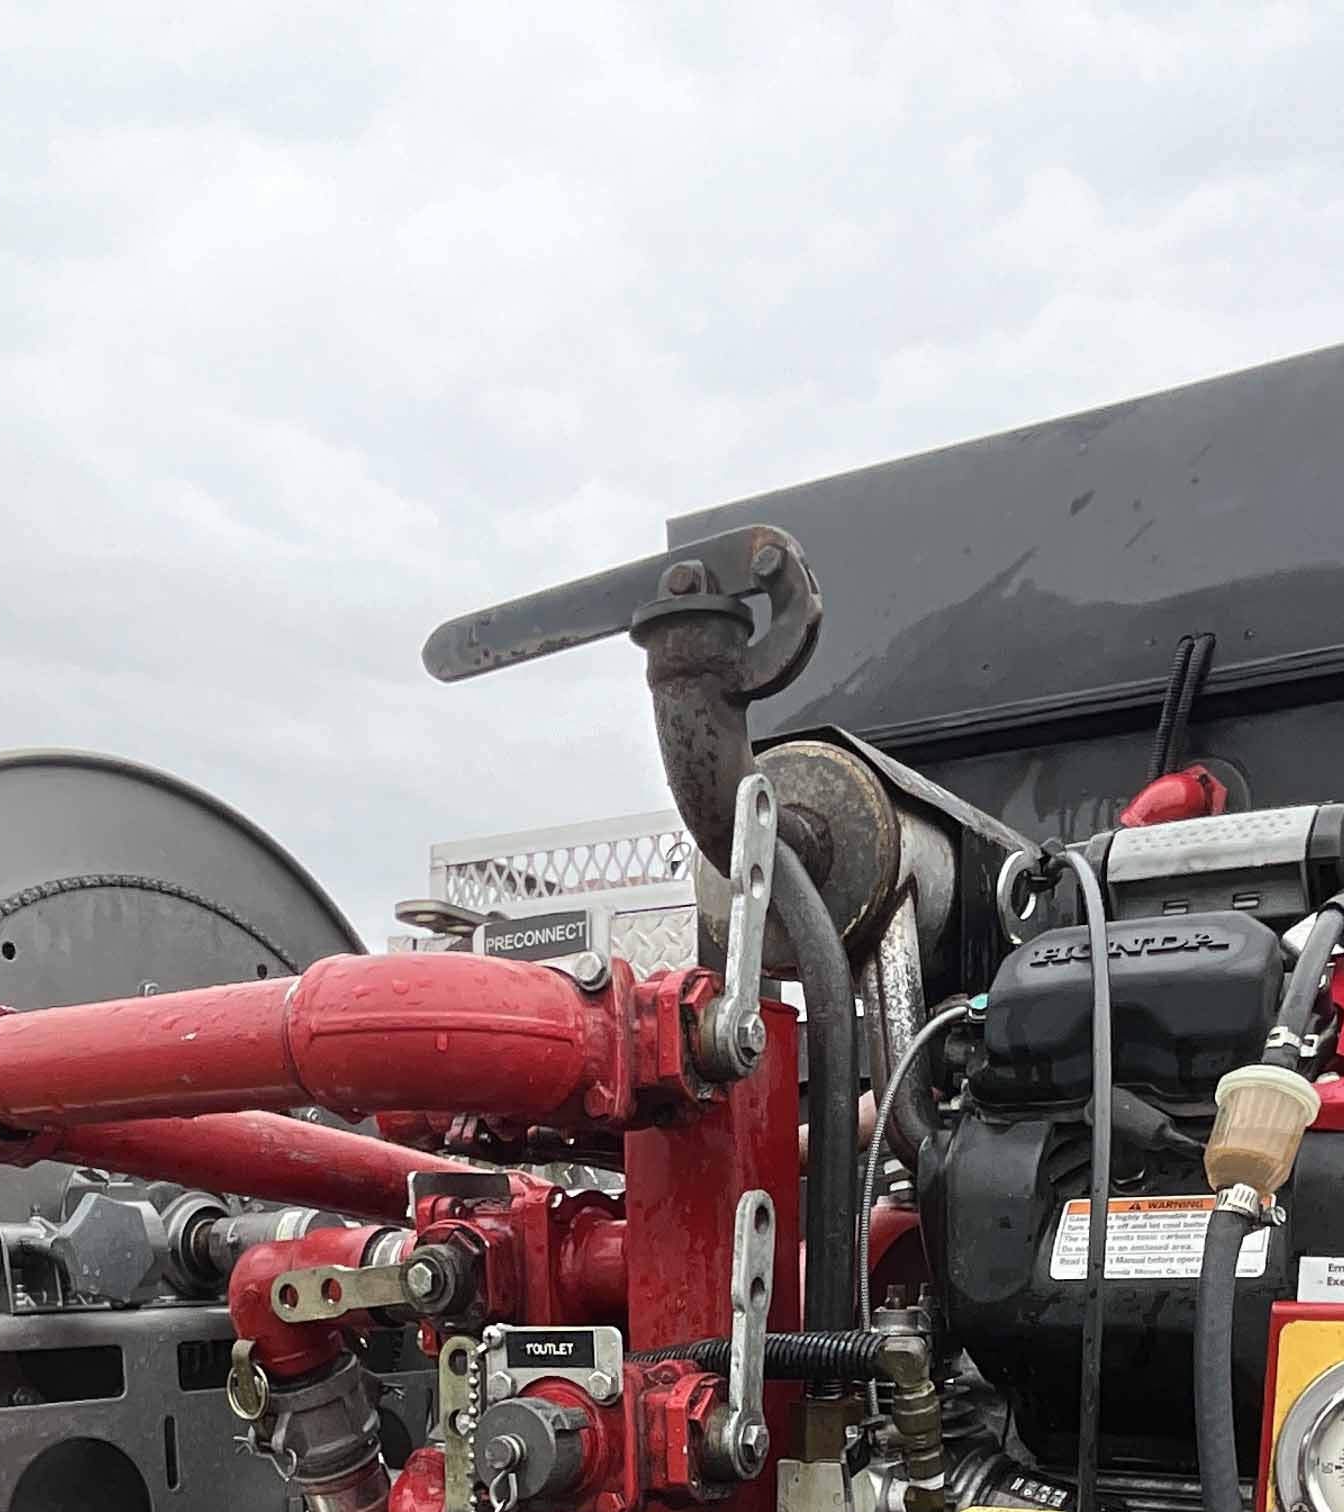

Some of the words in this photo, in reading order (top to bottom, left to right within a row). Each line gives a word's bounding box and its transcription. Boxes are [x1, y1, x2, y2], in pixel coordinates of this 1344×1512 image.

[486, 921, 585, 953] PRECONNECT
[1030, 934, 1229, 967] HONDA
[1148, 1199, 1203, 1209] WARNING
